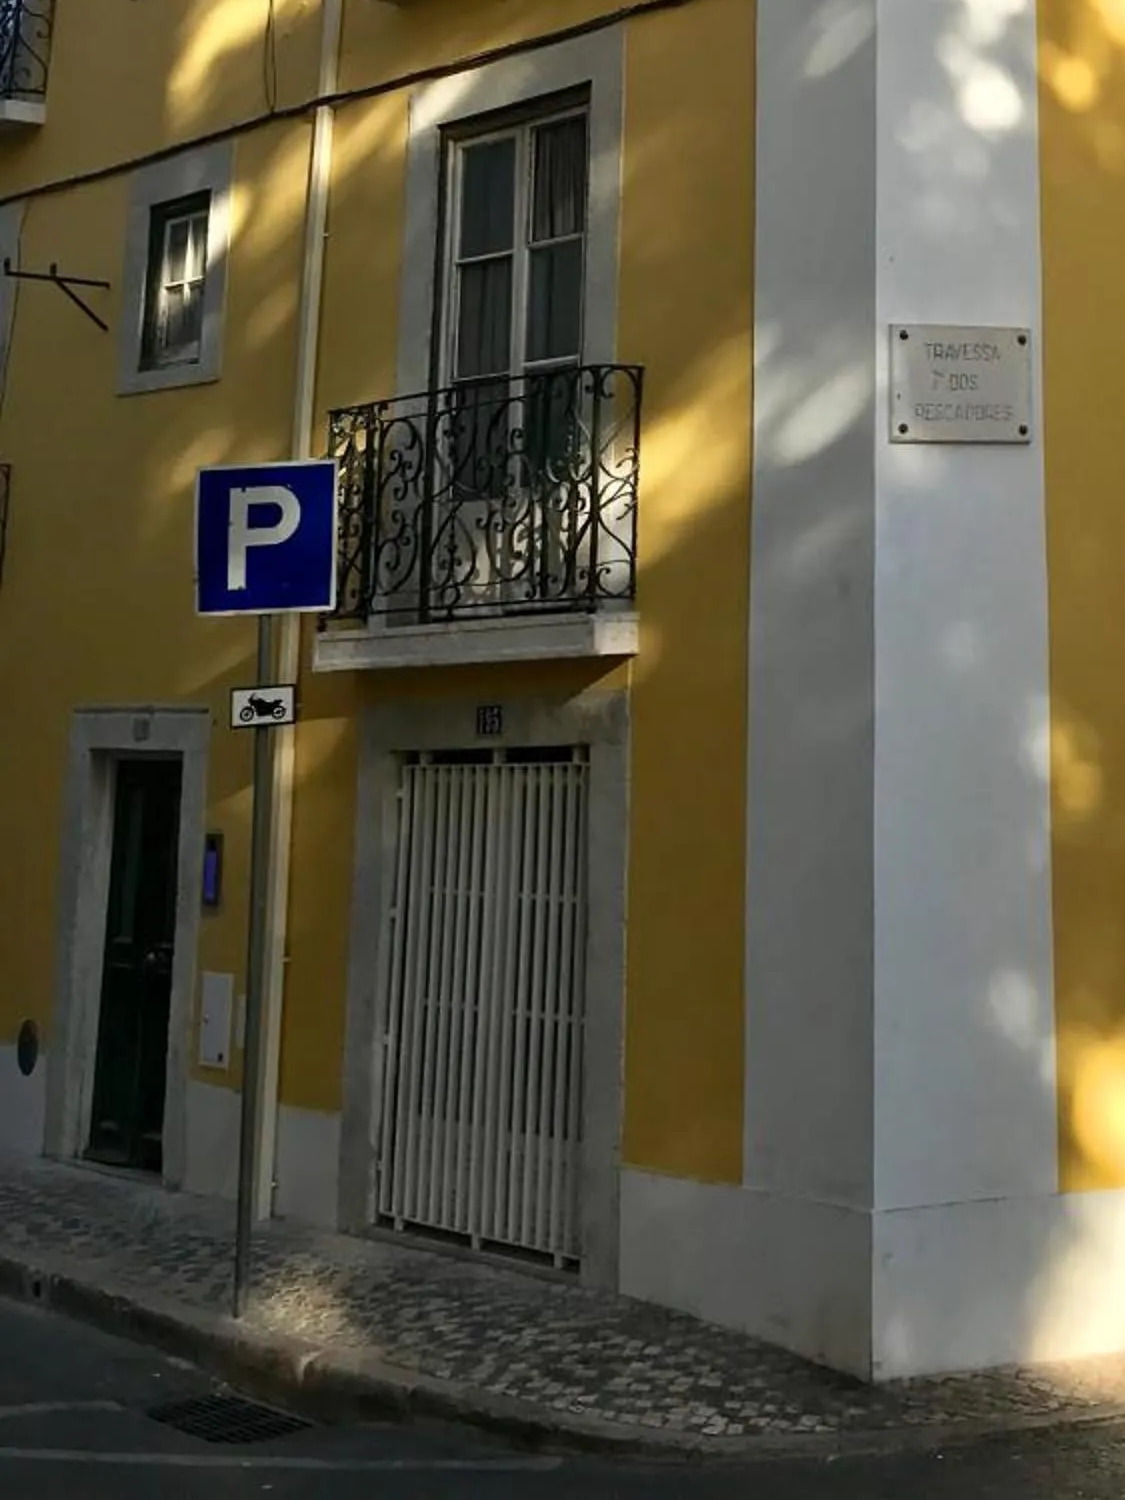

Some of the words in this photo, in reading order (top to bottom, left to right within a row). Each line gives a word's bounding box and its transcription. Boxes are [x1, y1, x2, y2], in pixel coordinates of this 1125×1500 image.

[925, 342, 1002, 361] TRAVESSA
[949, 373, 980, 391] DOS
[227, 484, 301, 591] P
